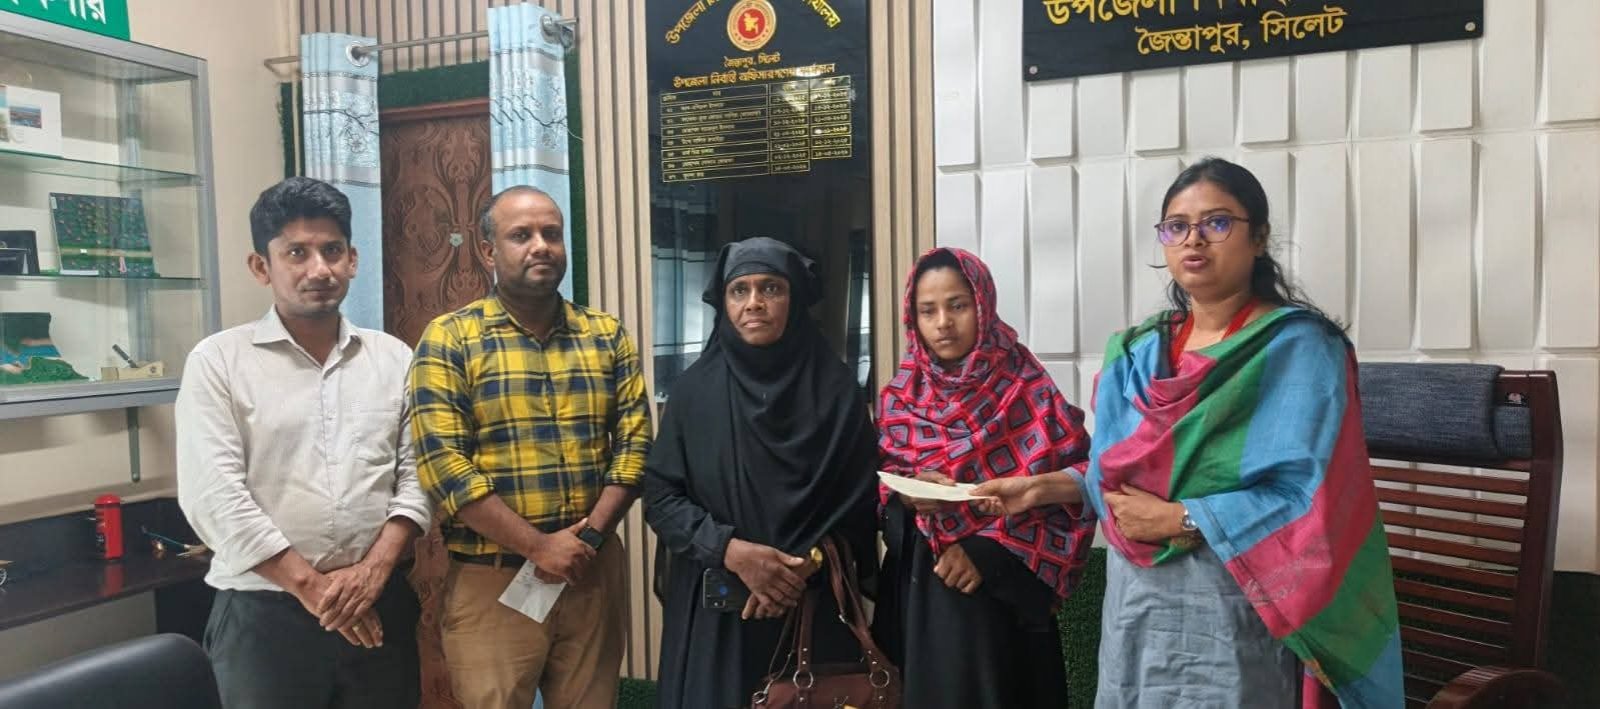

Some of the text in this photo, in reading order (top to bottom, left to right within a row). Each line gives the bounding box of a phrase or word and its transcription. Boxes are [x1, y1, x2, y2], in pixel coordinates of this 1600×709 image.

[1042, 0, 1175, 25] উপজেলা
[1135, 4, 1348, 56] জৈন্তাপুর, সিলেট
